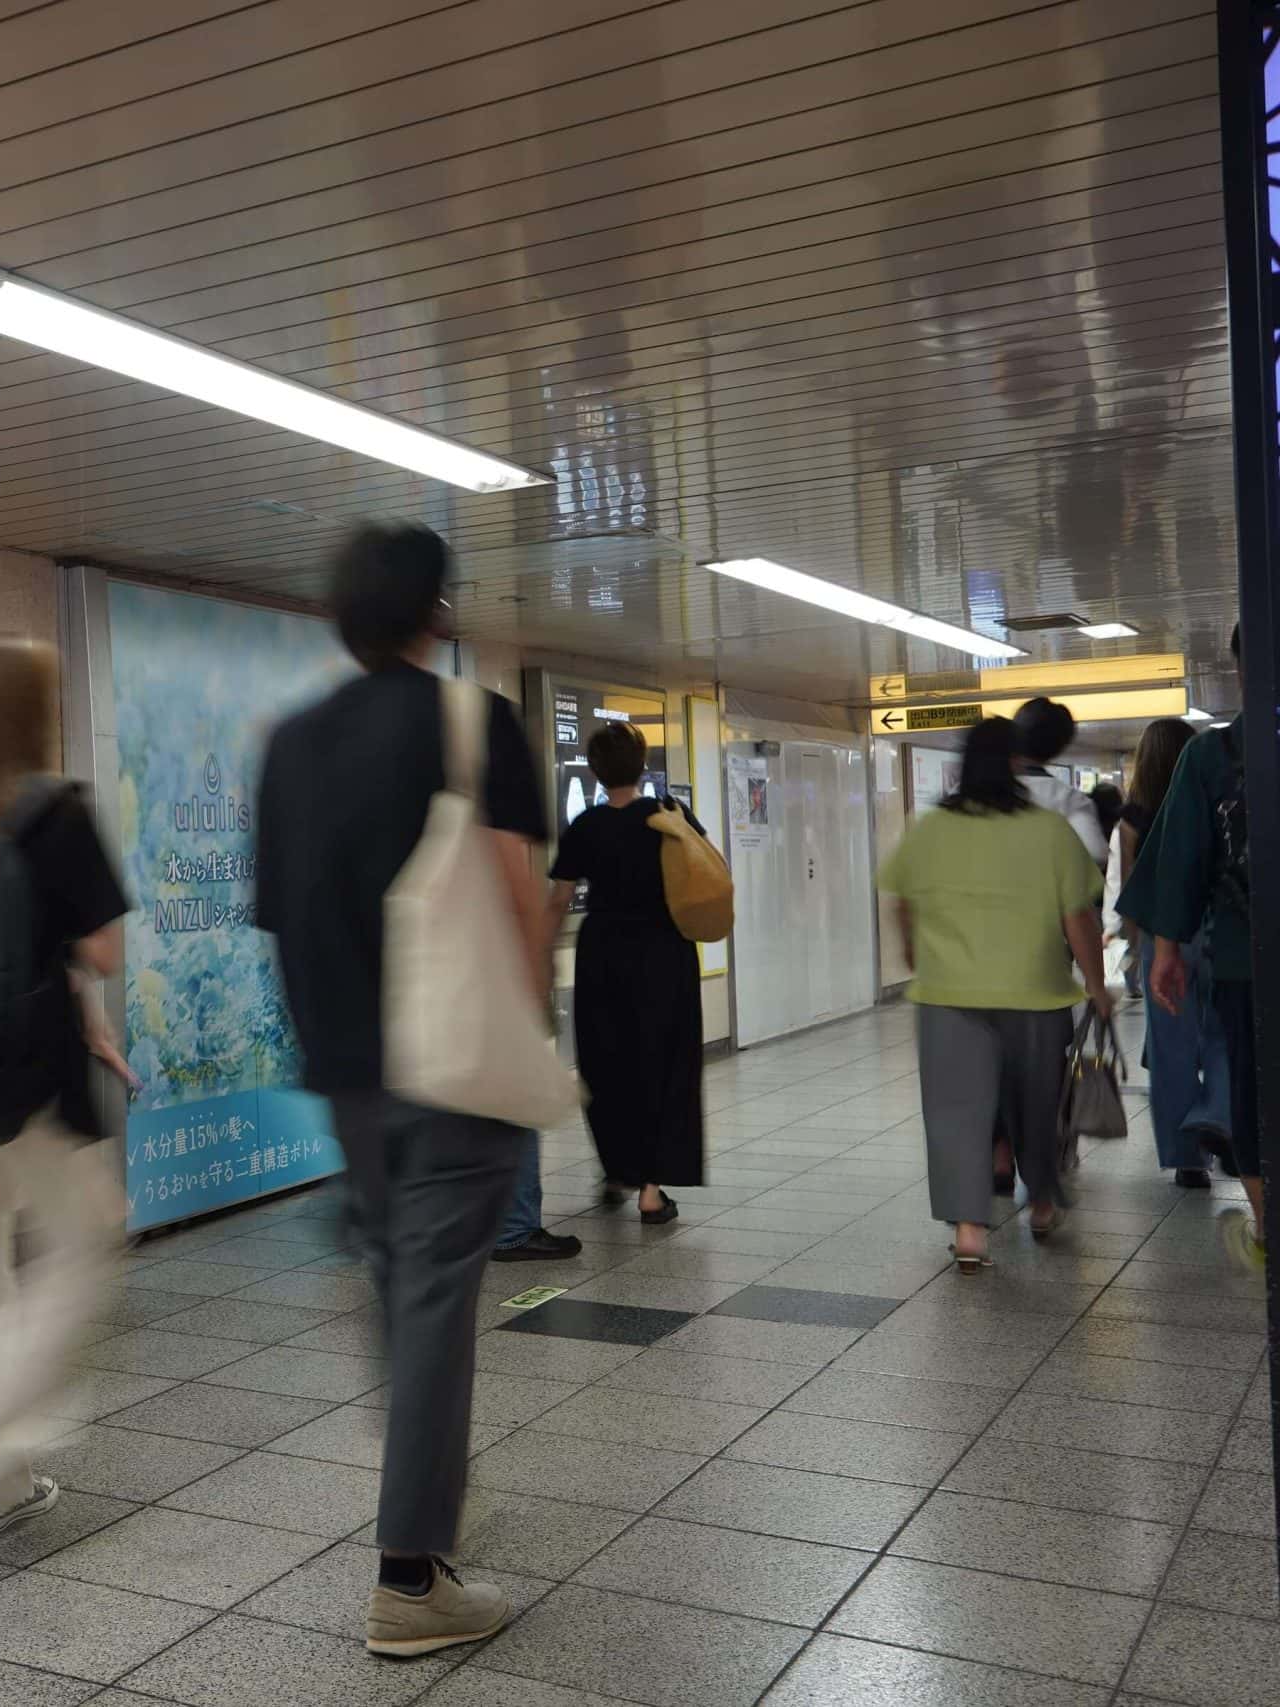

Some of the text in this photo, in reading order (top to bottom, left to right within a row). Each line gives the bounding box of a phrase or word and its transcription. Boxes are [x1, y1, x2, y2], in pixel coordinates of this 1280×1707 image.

[175, 795, 251, 832] ululis
[143, 1115, 256, 1163] 水分量15%の髪へ
